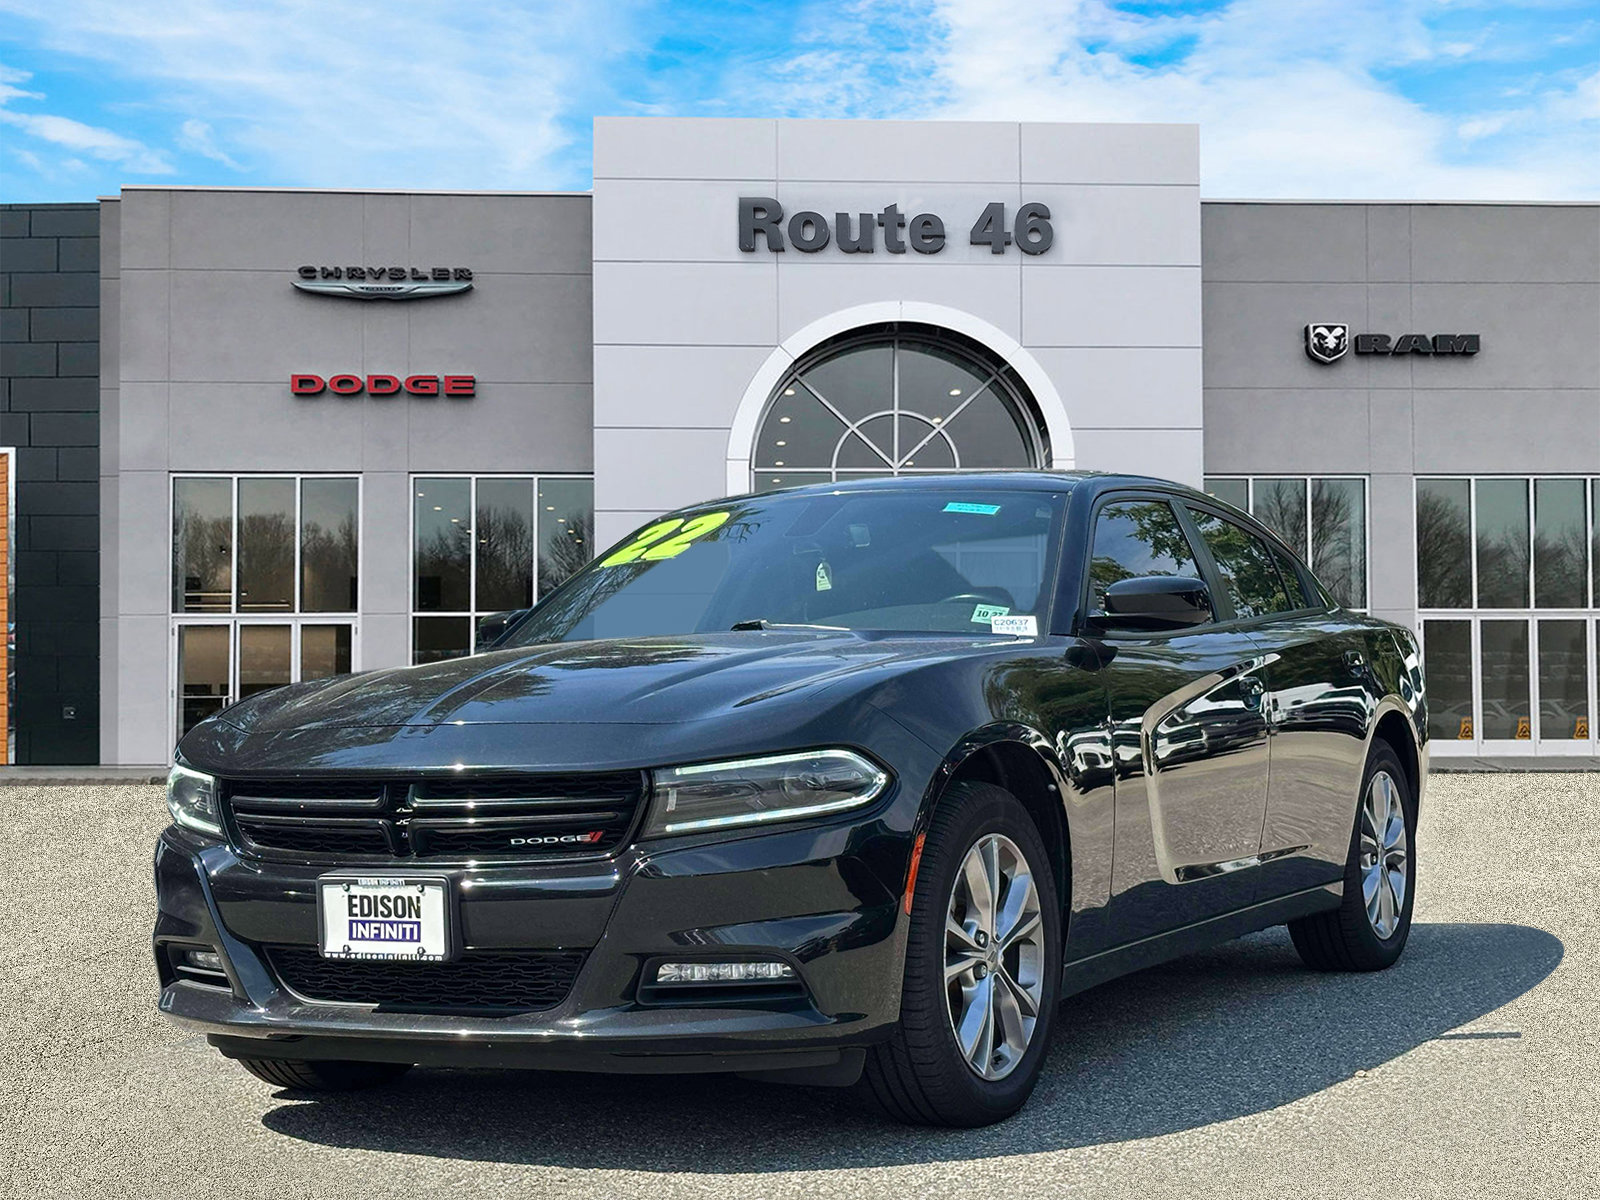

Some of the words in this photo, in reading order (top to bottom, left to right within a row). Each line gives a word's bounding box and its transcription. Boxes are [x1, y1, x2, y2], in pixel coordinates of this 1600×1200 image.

[738, 197, 946, 254] Route
[970, 202, 1054, 255] 46
[297, 265, 473, 281] CHRYSLER
[1354, 333, 1481, 356] RAM
[290, 374, 476, 397] DODGE
[599, 511, 731, 569] 22
[976, 610, 989, 618] 10
[510, 834, 592, 846] DODGE
[347, 894, 421, 919] EDISON
[351, 922, 418, 941] INFINITI
